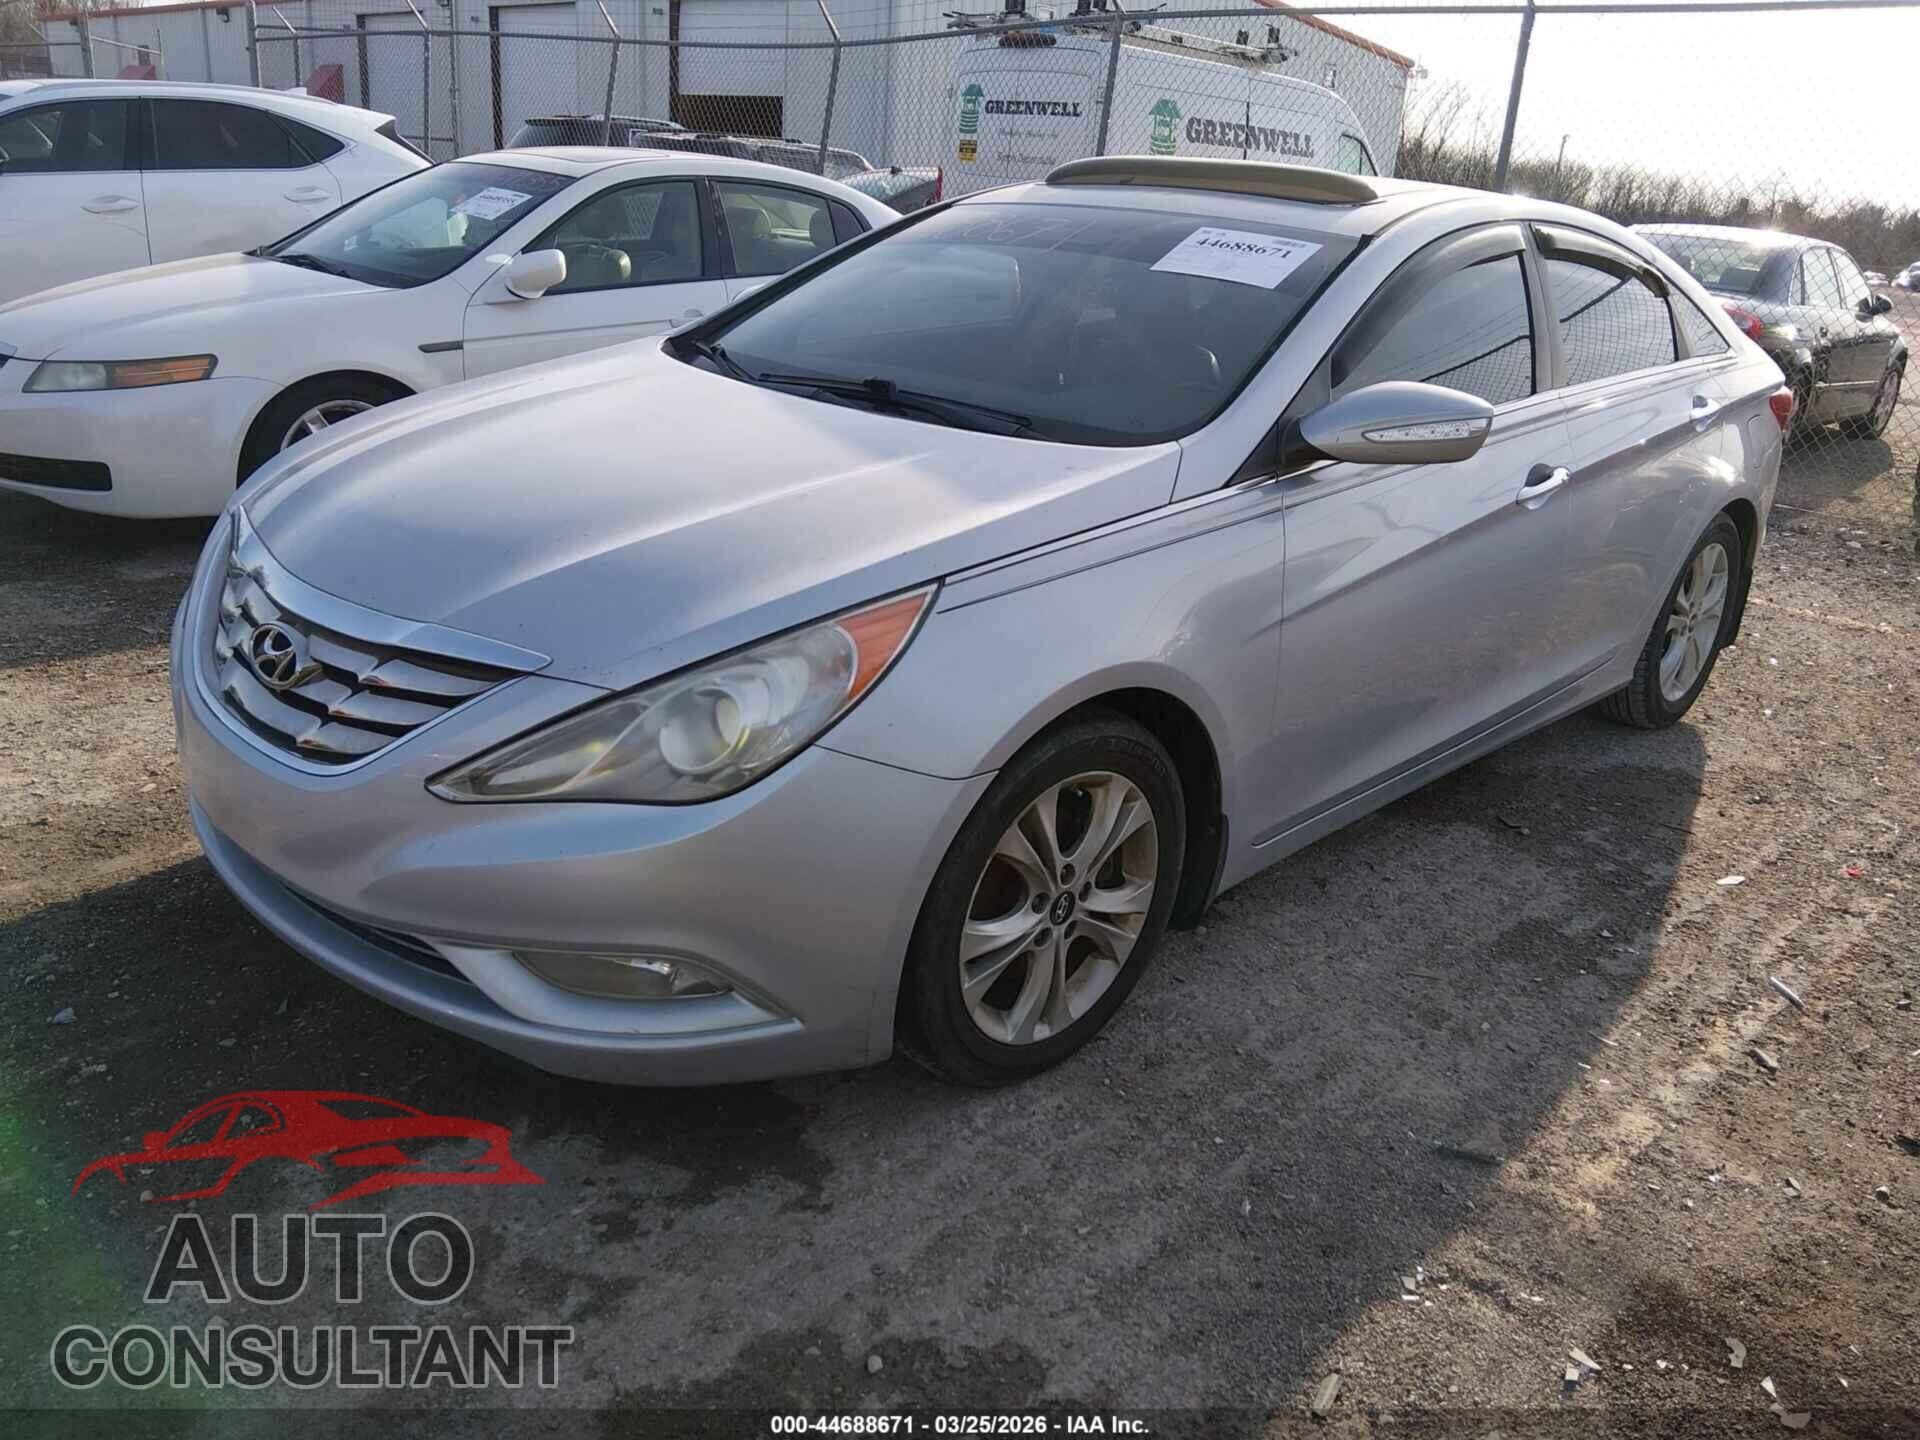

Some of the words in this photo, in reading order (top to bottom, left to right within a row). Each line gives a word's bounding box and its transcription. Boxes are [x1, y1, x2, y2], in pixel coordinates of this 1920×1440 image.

[985, 100, 1082, 118] GREENWELL
[1186, 117, 1314, 159] GREENWELL
[1196, 237, 1293, 260] 44688671
